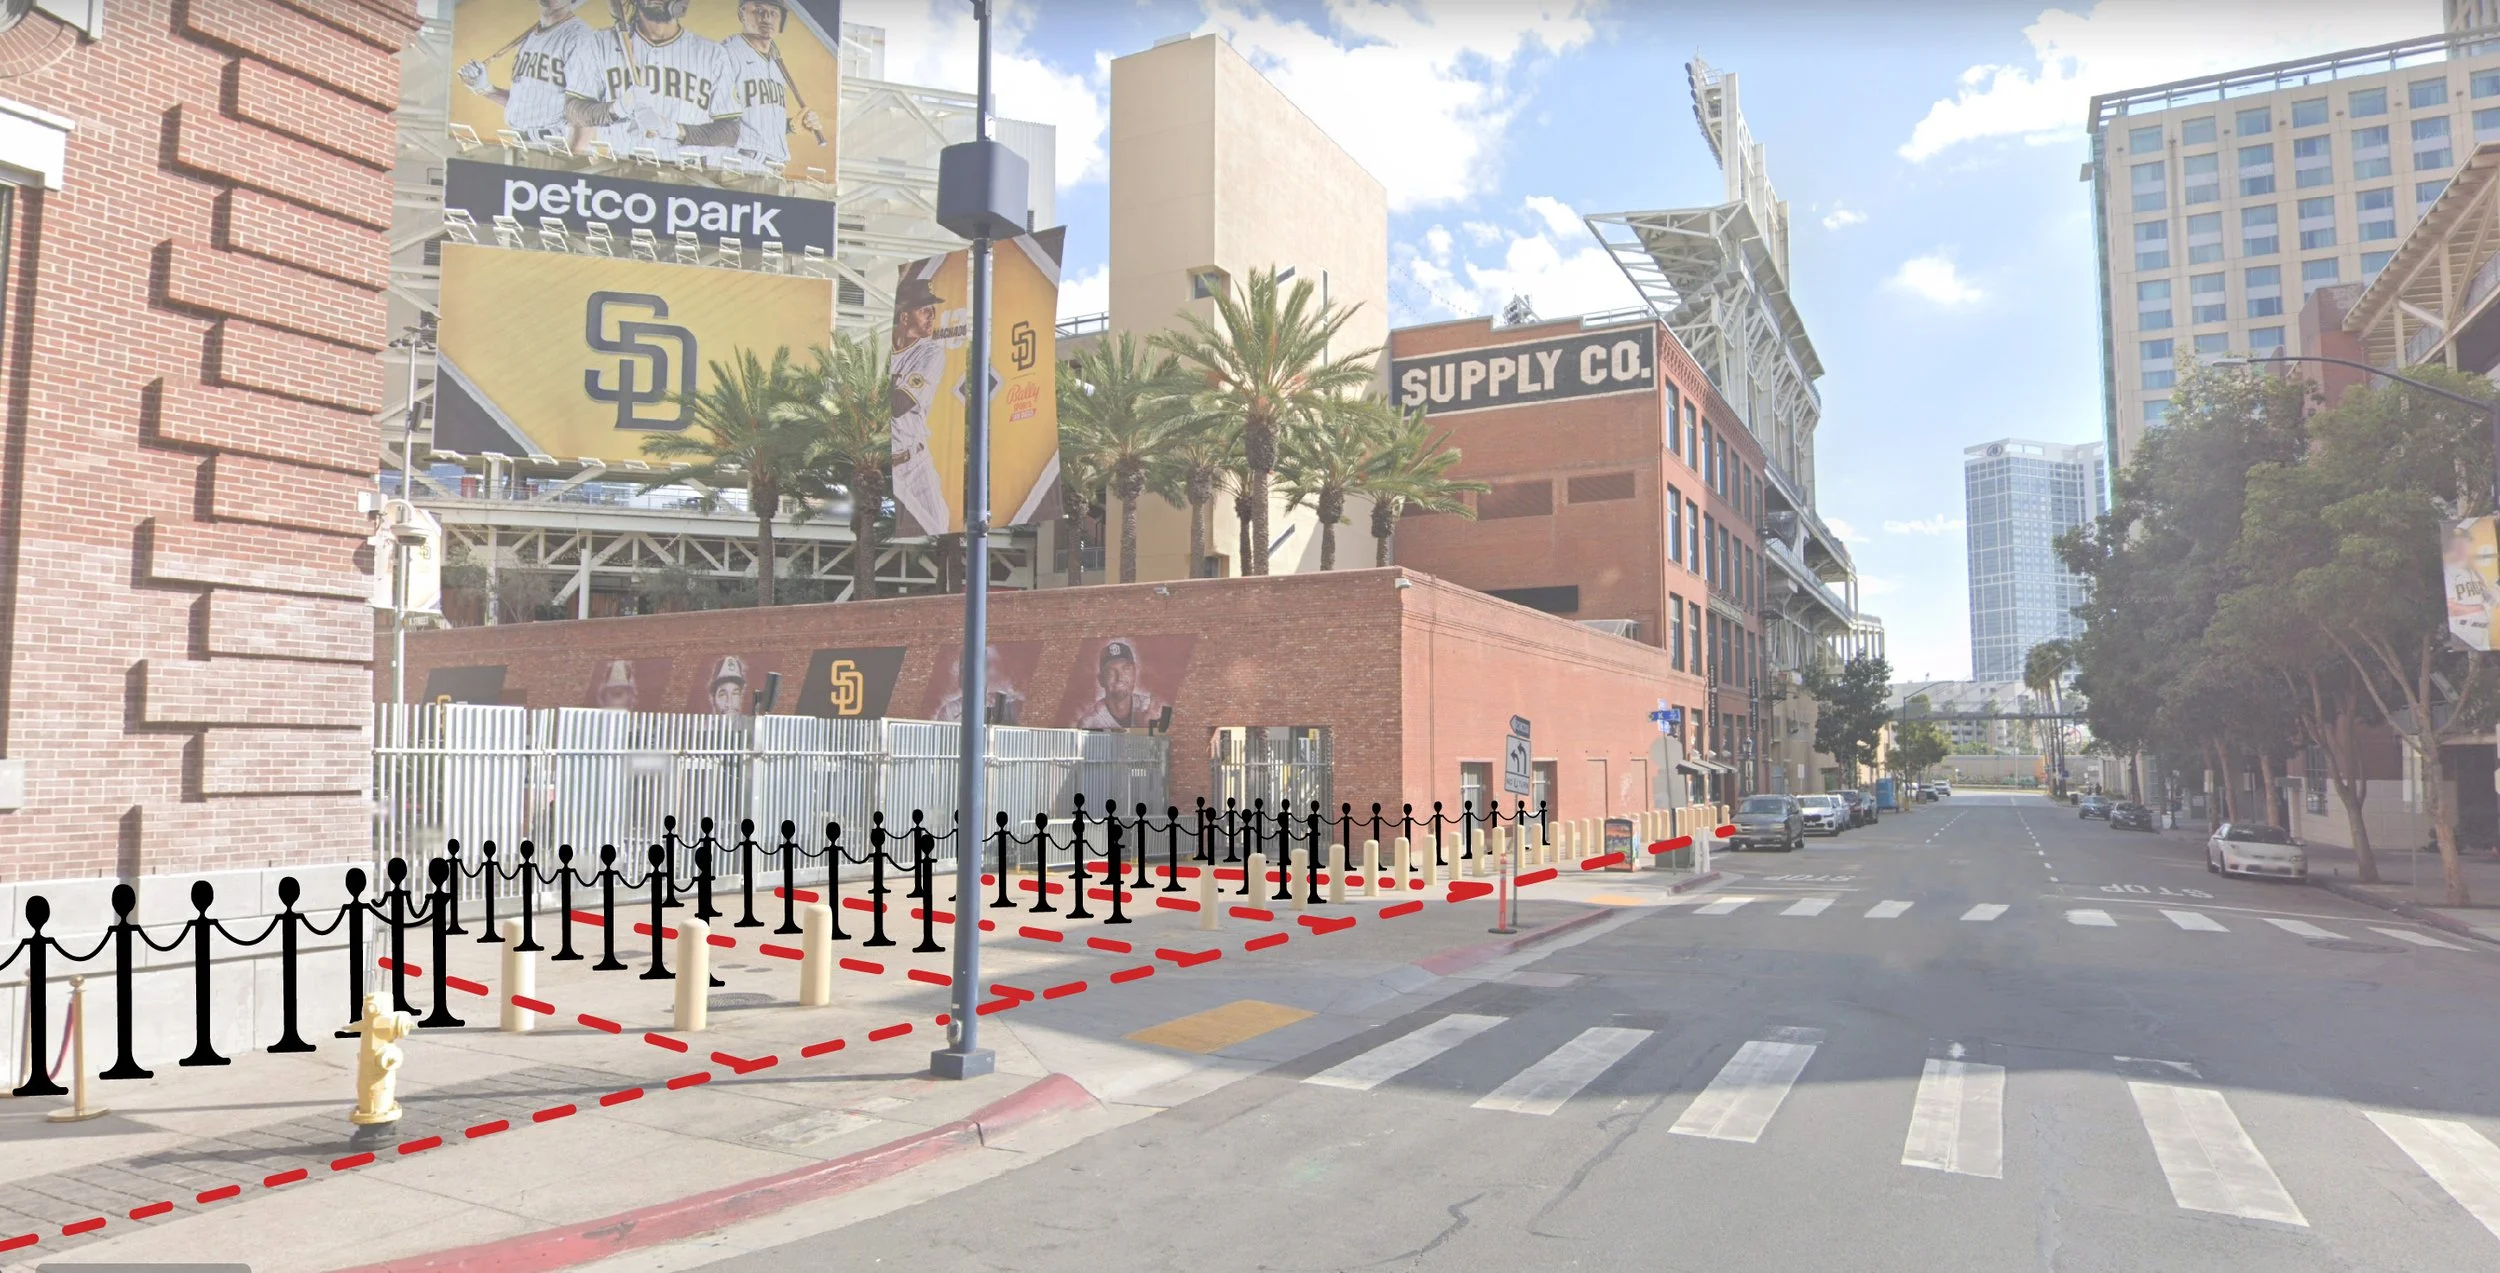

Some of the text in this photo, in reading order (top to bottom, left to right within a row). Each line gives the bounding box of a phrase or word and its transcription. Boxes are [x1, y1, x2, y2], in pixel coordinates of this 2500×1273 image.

[504, 179, 782, 238] petco park
[1401, 340, 1651, 407] SUPPLY CO.
